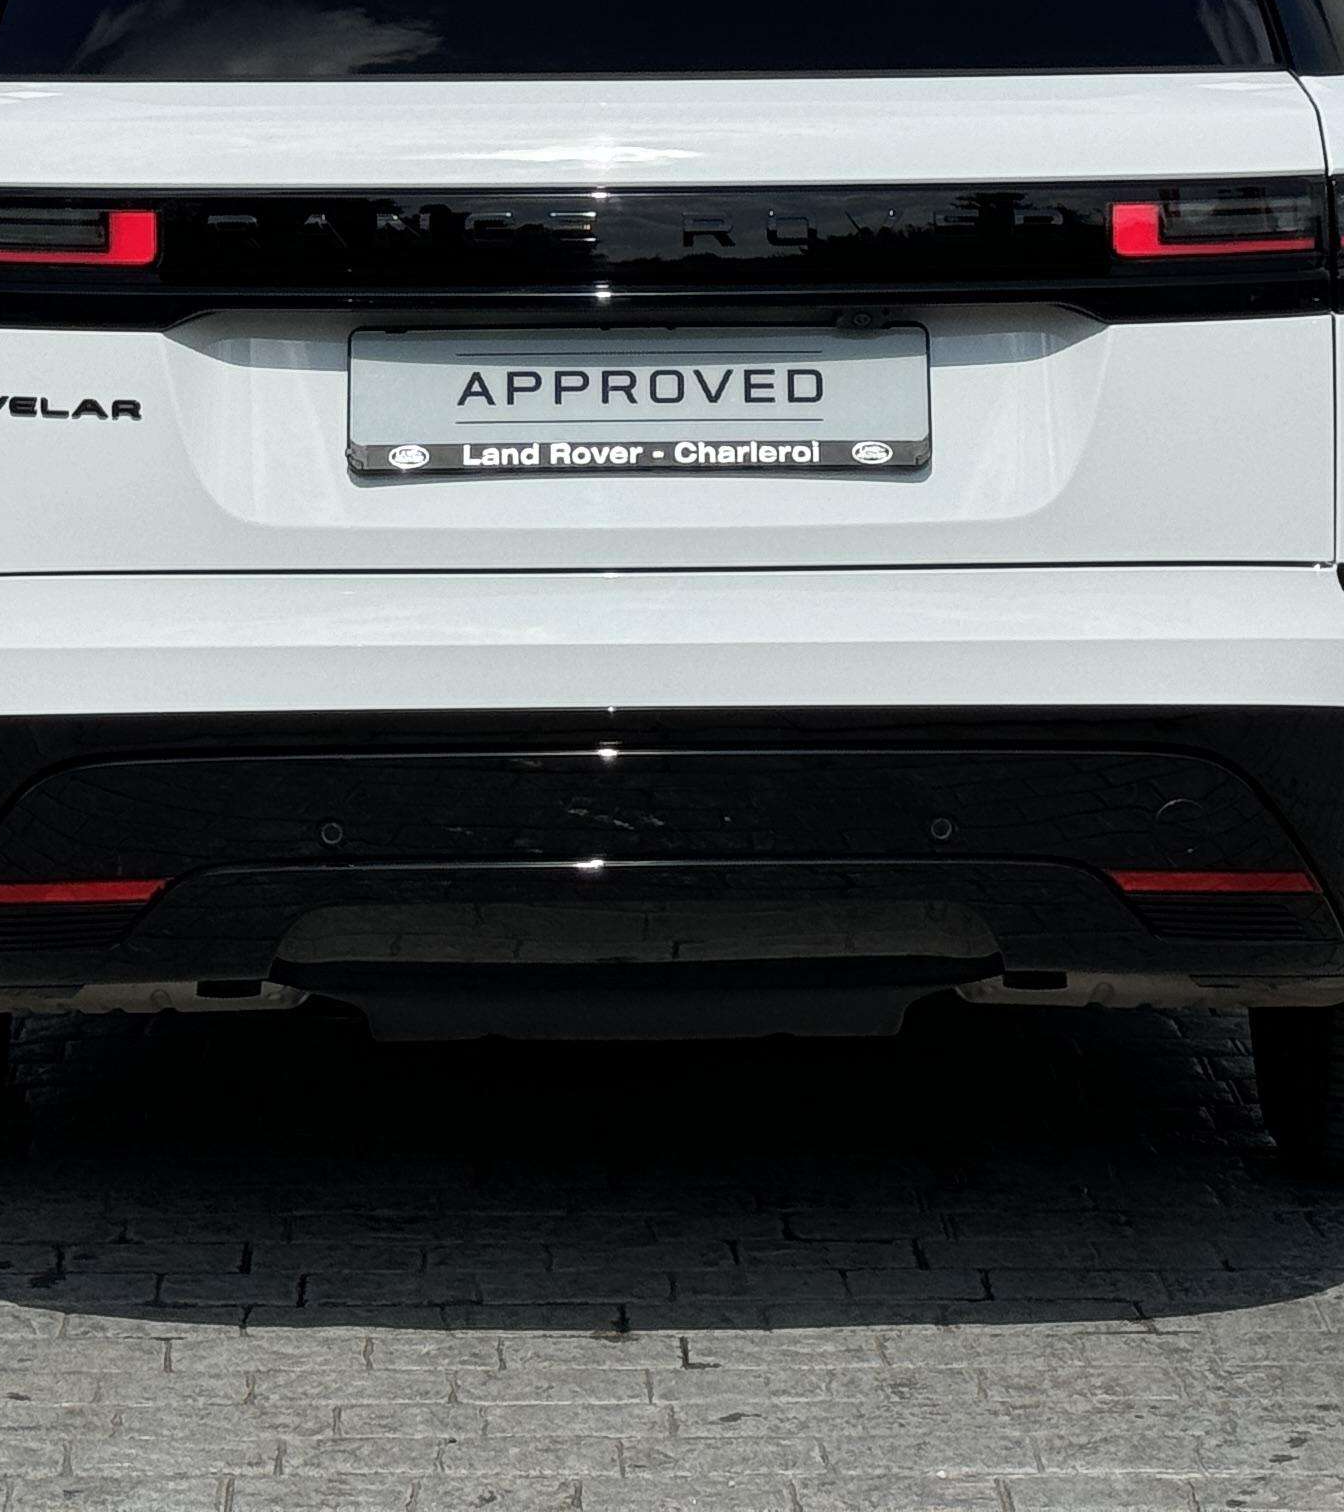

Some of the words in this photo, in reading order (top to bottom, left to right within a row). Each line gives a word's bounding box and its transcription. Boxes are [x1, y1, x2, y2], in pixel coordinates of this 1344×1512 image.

[456, 368, 824, 407] APPROVED
[462, 443, 540, 466] Land
[549, 442, 644, 466] Rover
[673, 440, 820, 465] Charleroi
